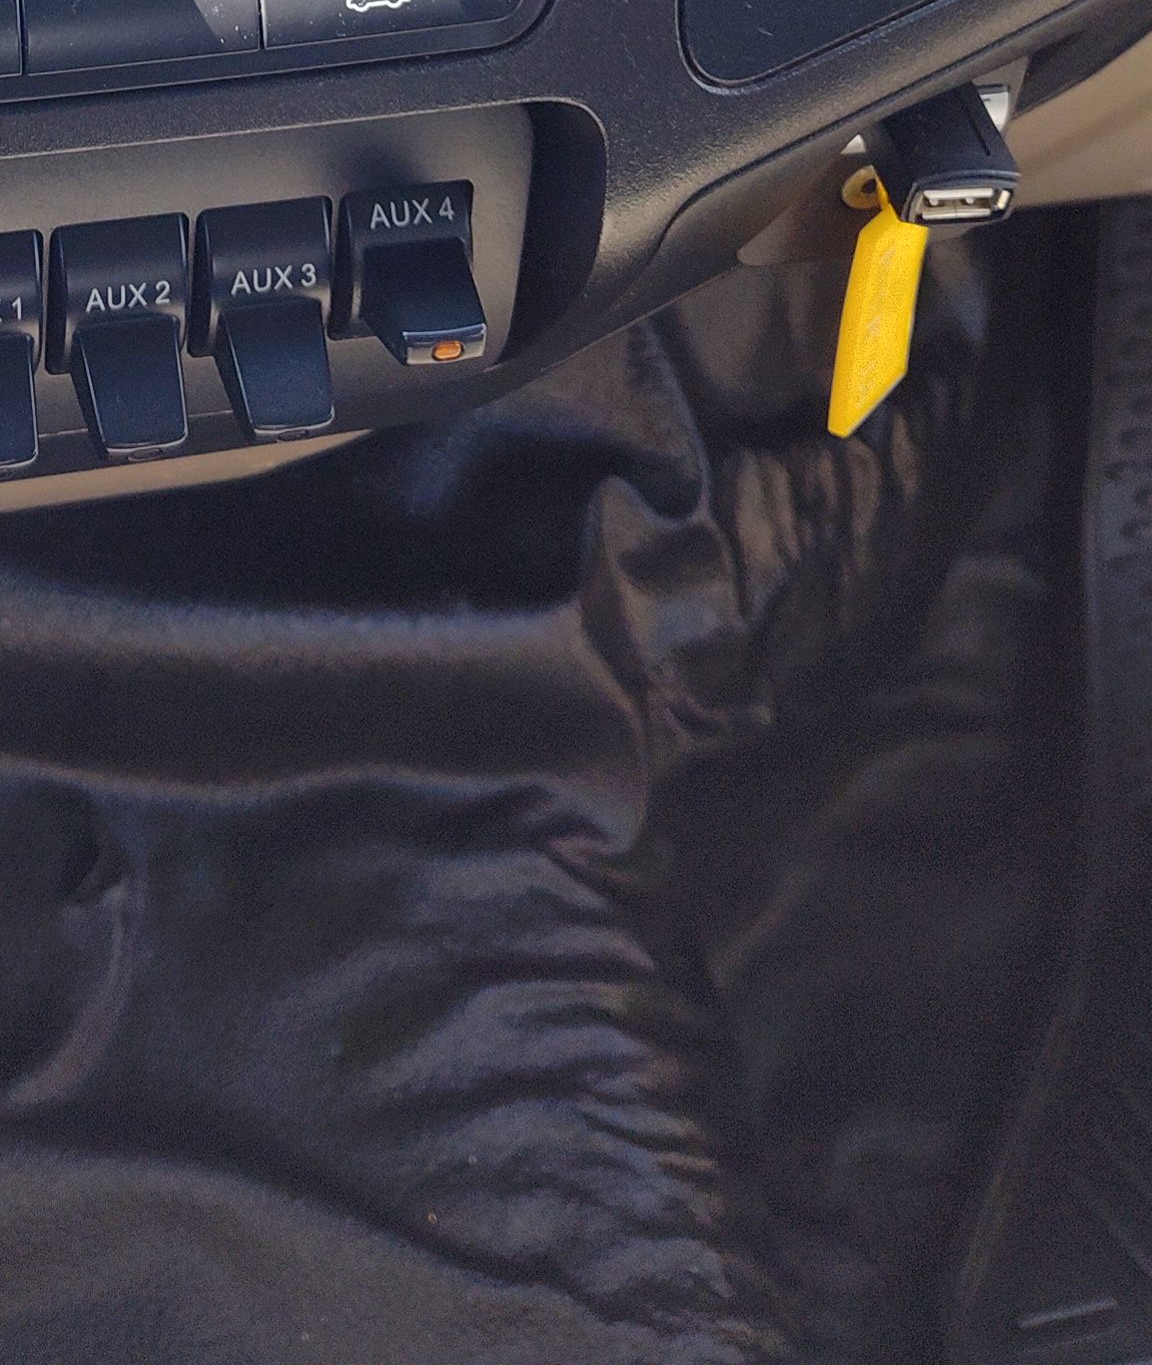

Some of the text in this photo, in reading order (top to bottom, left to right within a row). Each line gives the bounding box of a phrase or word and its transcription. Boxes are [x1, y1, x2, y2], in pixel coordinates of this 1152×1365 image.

[370, 196, 456, 230] AUX 4
[231, 263, 318, 295] AUX 3
[12, 299, 24, 321] 1
[85, 281, 171, 313] AUX 2
